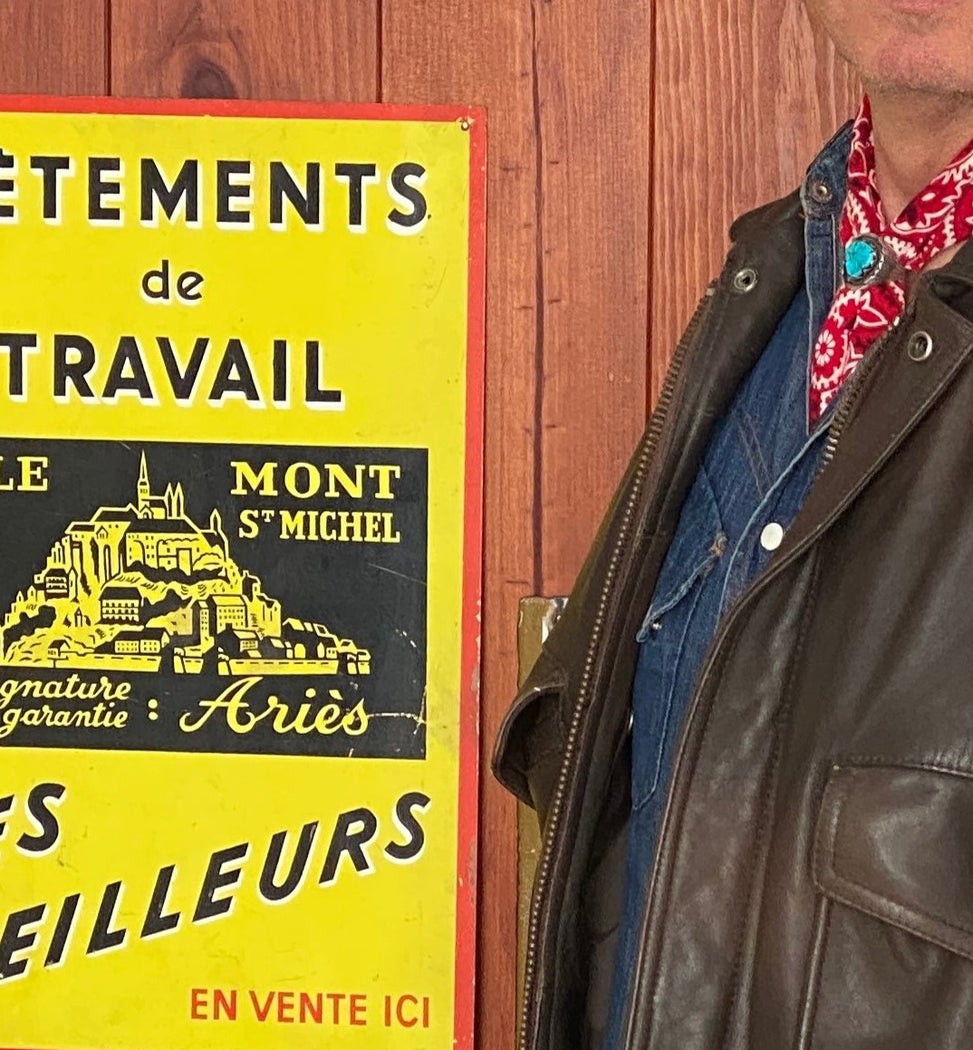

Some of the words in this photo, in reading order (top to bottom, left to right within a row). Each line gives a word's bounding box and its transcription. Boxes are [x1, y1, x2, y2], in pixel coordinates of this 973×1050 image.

[141, 259, 204, 302] de
[0, 331, 344, 409] TRAVAIL
[230, 460, 401, 499] MONT
[280, 511, 401, 543] MICHEL
[0, 673, 132, 710] gnature
[0, 701, 129, 739] garantie
[179, 676, 370, 736] Ariès
[0, 791, 431, 983] EILLEURS
[190, 988, 238, 1021] EN
[249, 990, 367, 1026] VENTE
[384, 994, 430, 1029] ICI
